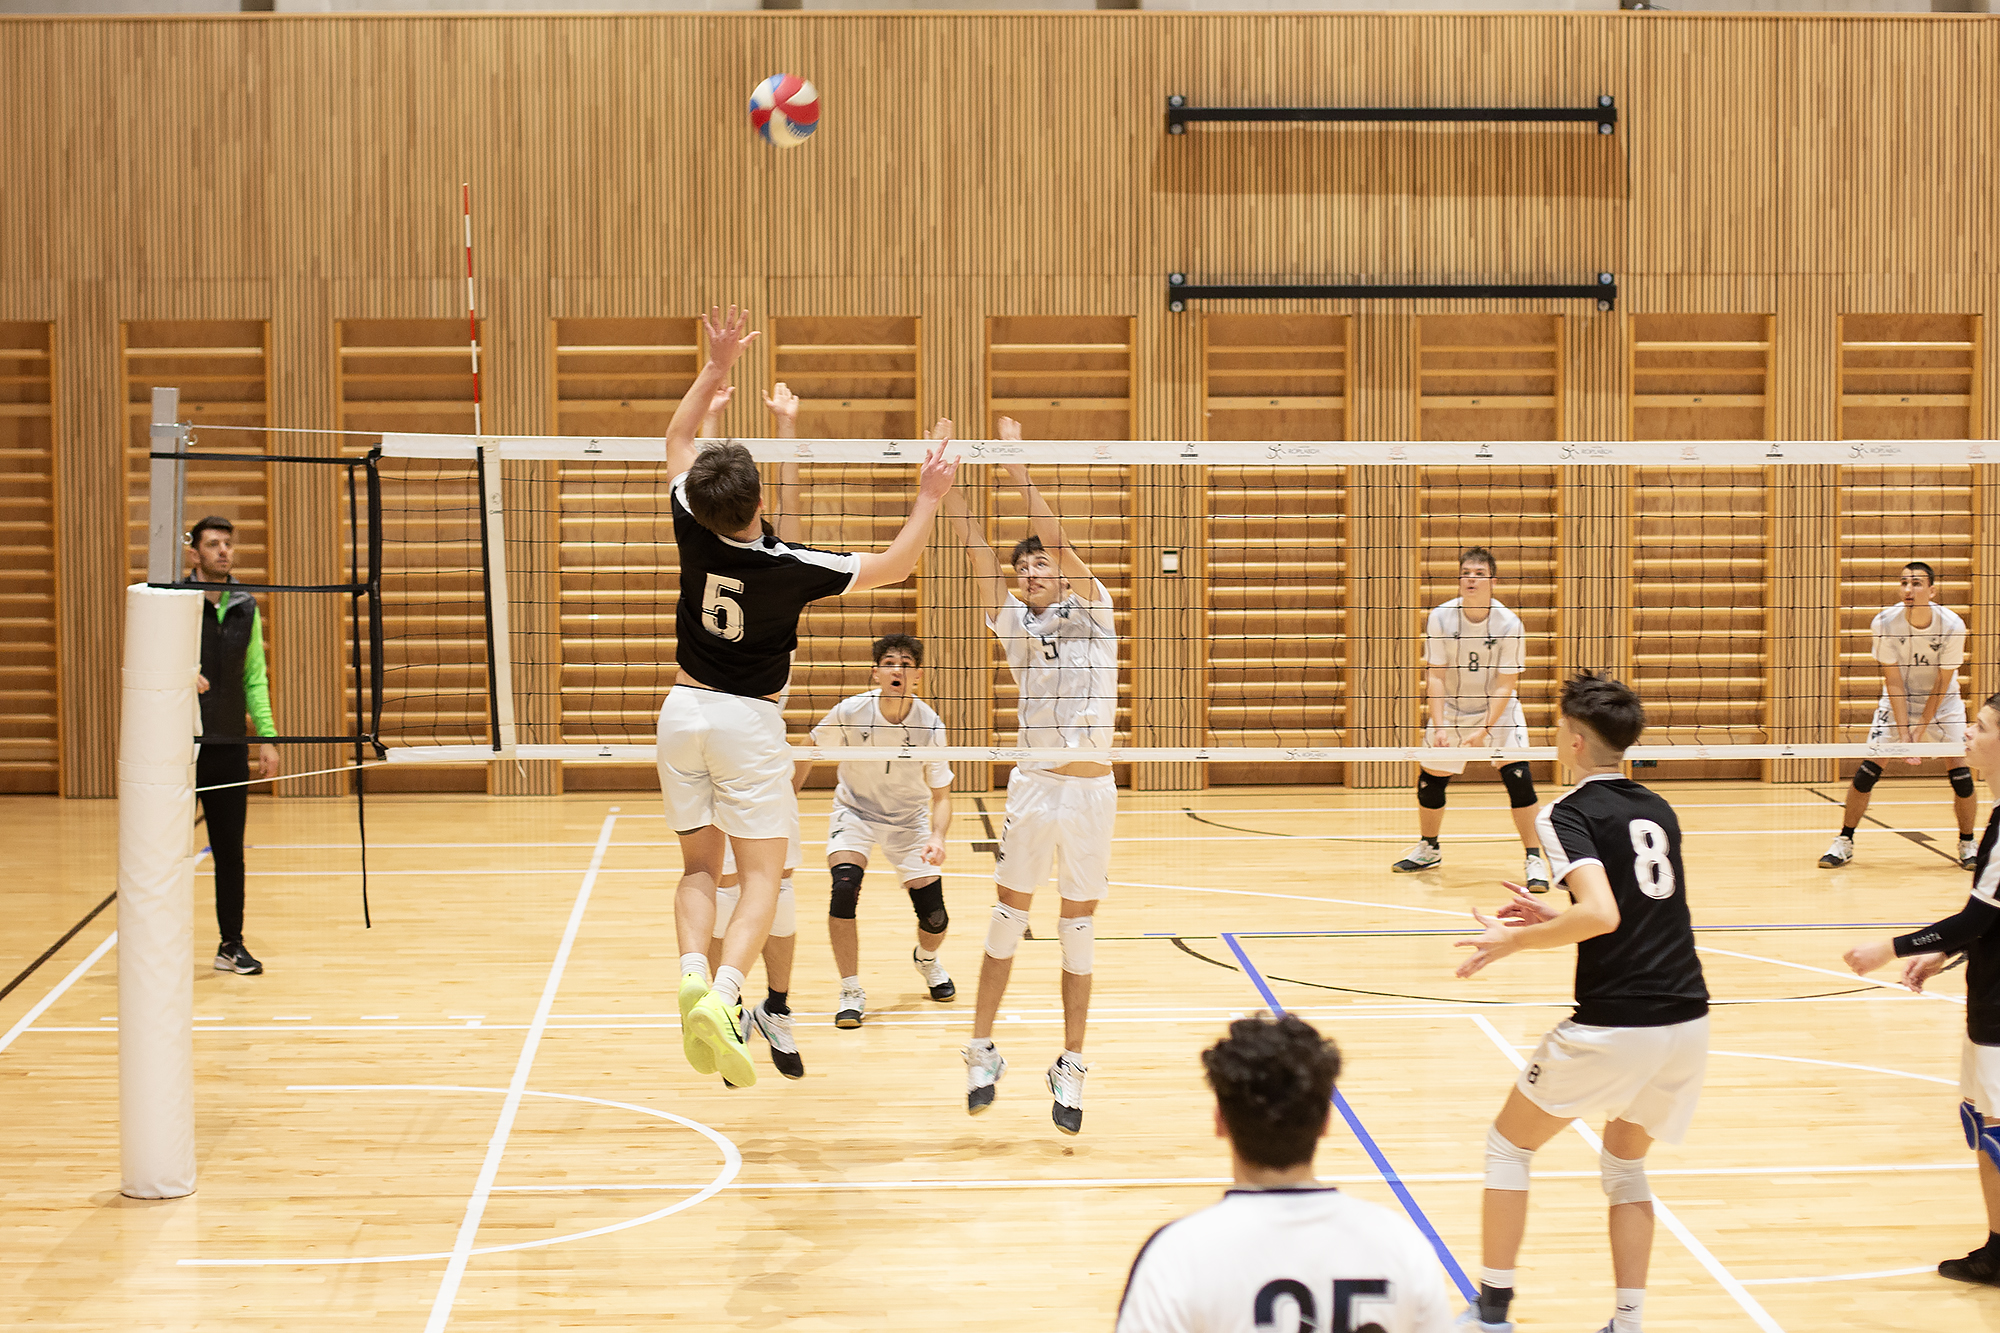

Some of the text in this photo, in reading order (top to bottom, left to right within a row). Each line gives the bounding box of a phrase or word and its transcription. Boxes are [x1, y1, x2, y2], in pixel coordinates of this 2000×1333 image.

[702, 572, 745, 643] 5
[1041, 636, 1059, 660] 5
[1914, 652, 1930, 666] 14
[1469, 651, 1479, 672] 8
[1628, 818, 1676, 900] 8
[1527, 1063, 1542, 1085] 8
